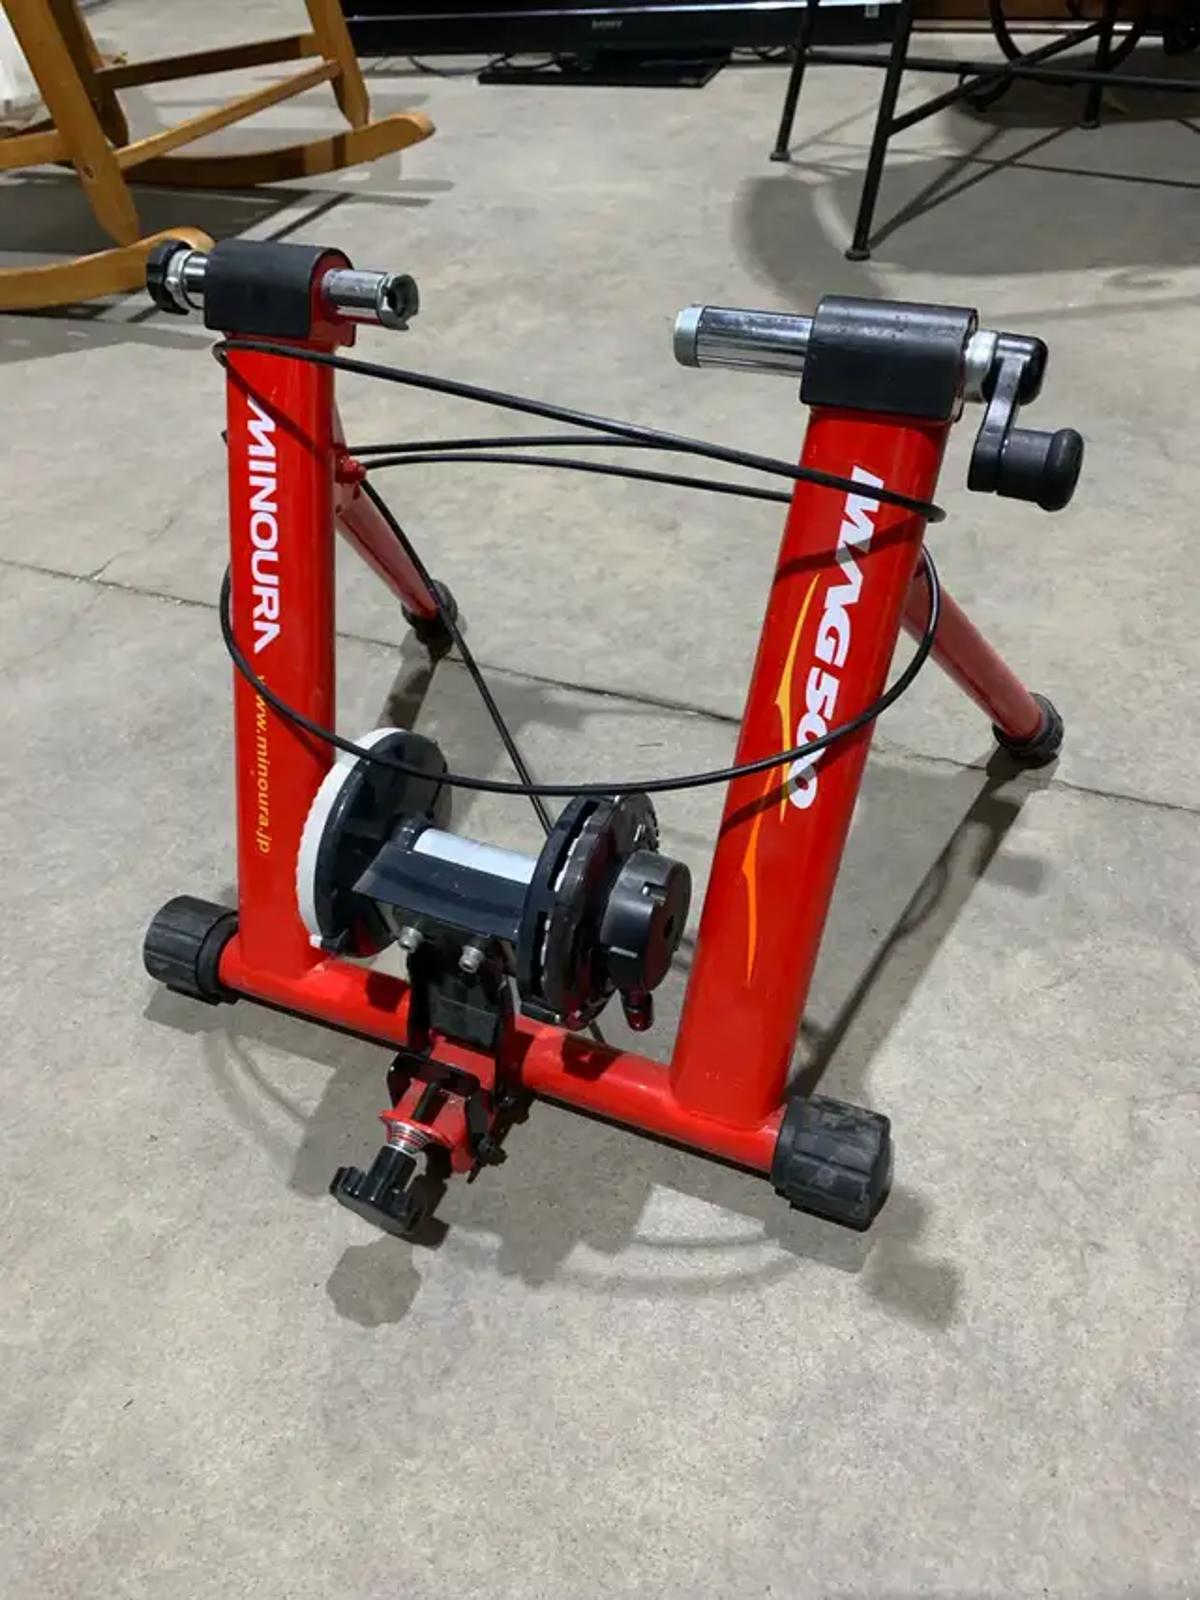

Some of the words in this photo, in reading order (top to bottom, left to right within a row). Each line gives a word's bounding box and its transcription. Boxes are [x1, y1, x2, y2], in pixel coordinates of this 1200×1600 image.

[247, 393, 281, 654] MINOURA
[814, 465, 884, 669] MAG
[787, 666, 840, 809] 500
